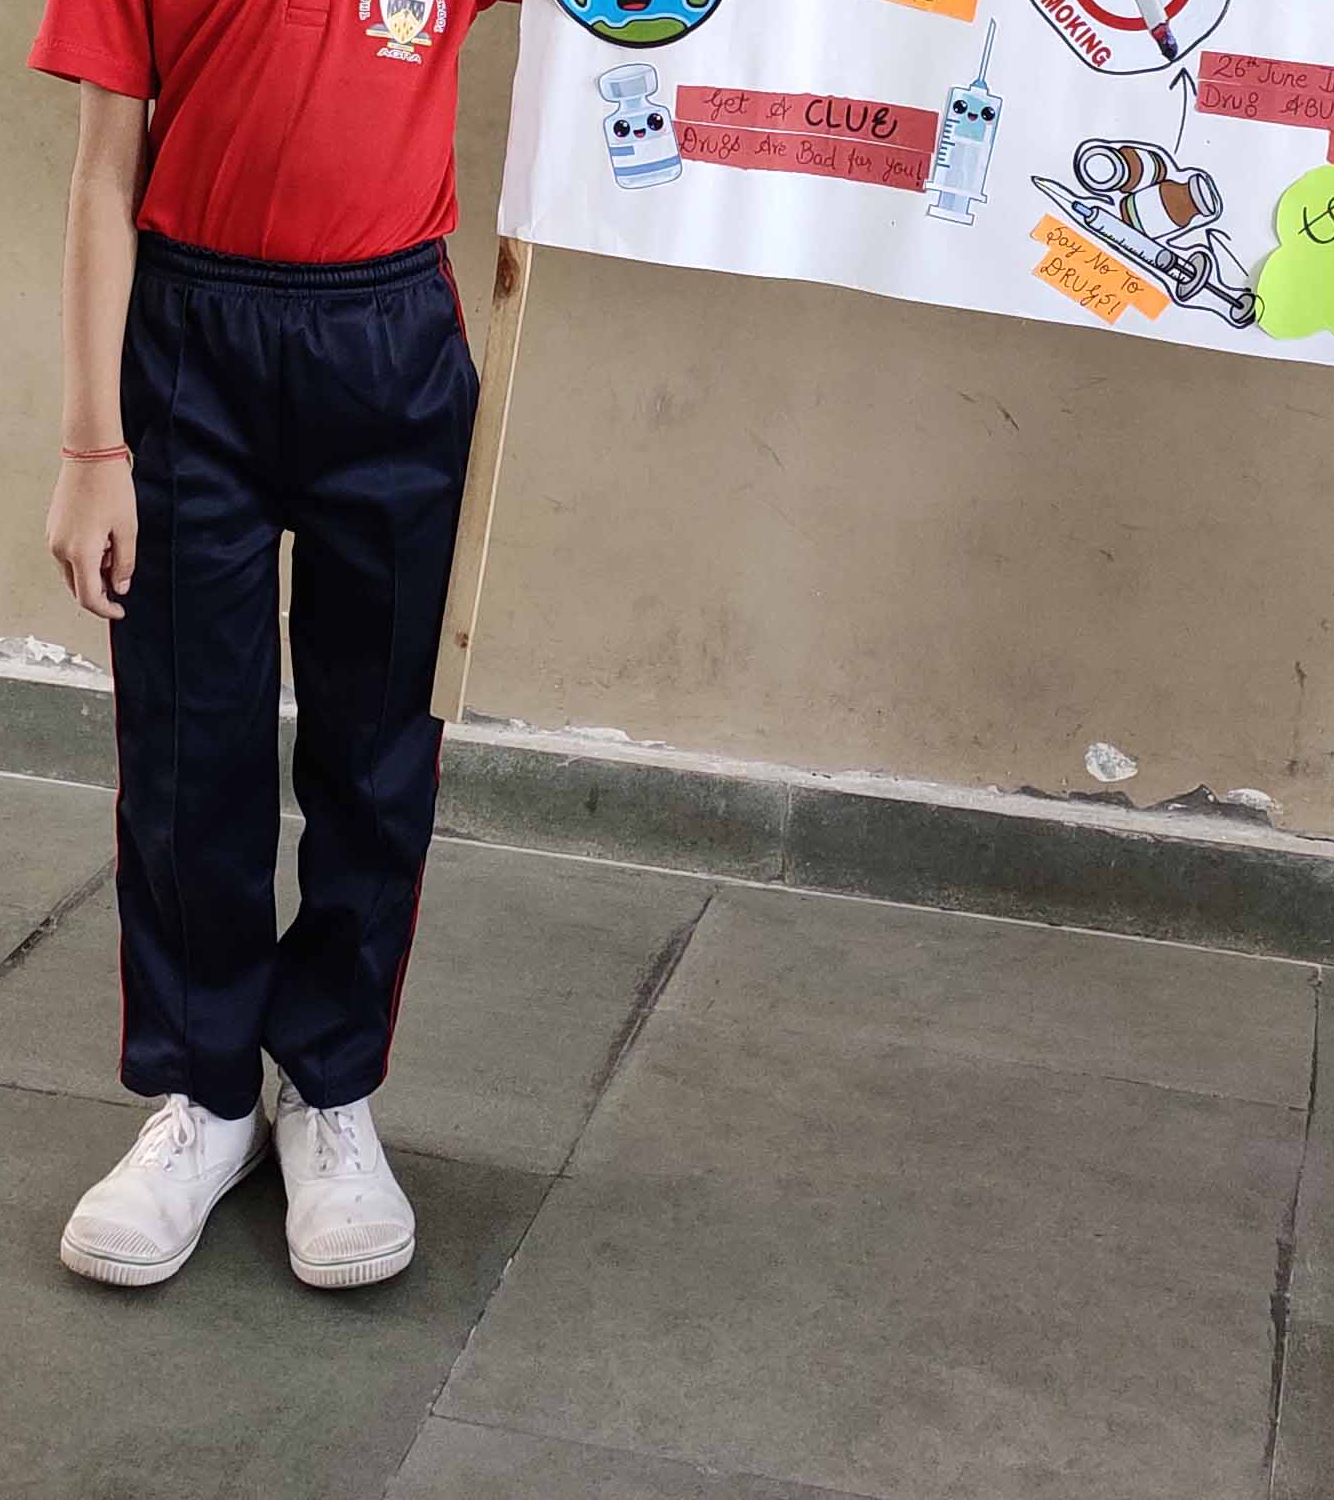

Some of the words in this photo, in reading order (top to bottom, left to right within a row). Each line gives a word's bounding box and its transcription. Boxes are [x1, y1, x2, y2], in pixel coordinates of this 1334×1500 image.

[1257, 60, 1308, 88] June
[765, 96, 793, 122] A
[804, 98, 898, 140] CLUE
[1200, 83, 1260, 118] Drug
[678, 126, 742, 158] Drugs
[754, 133, 788, 157] Are
[795, 139, 836, 171] Bad
[1046, 226, 1086, 258] Say
[1083, 251, 1118, 275] No
[1120, 270, 1145, 294] To
